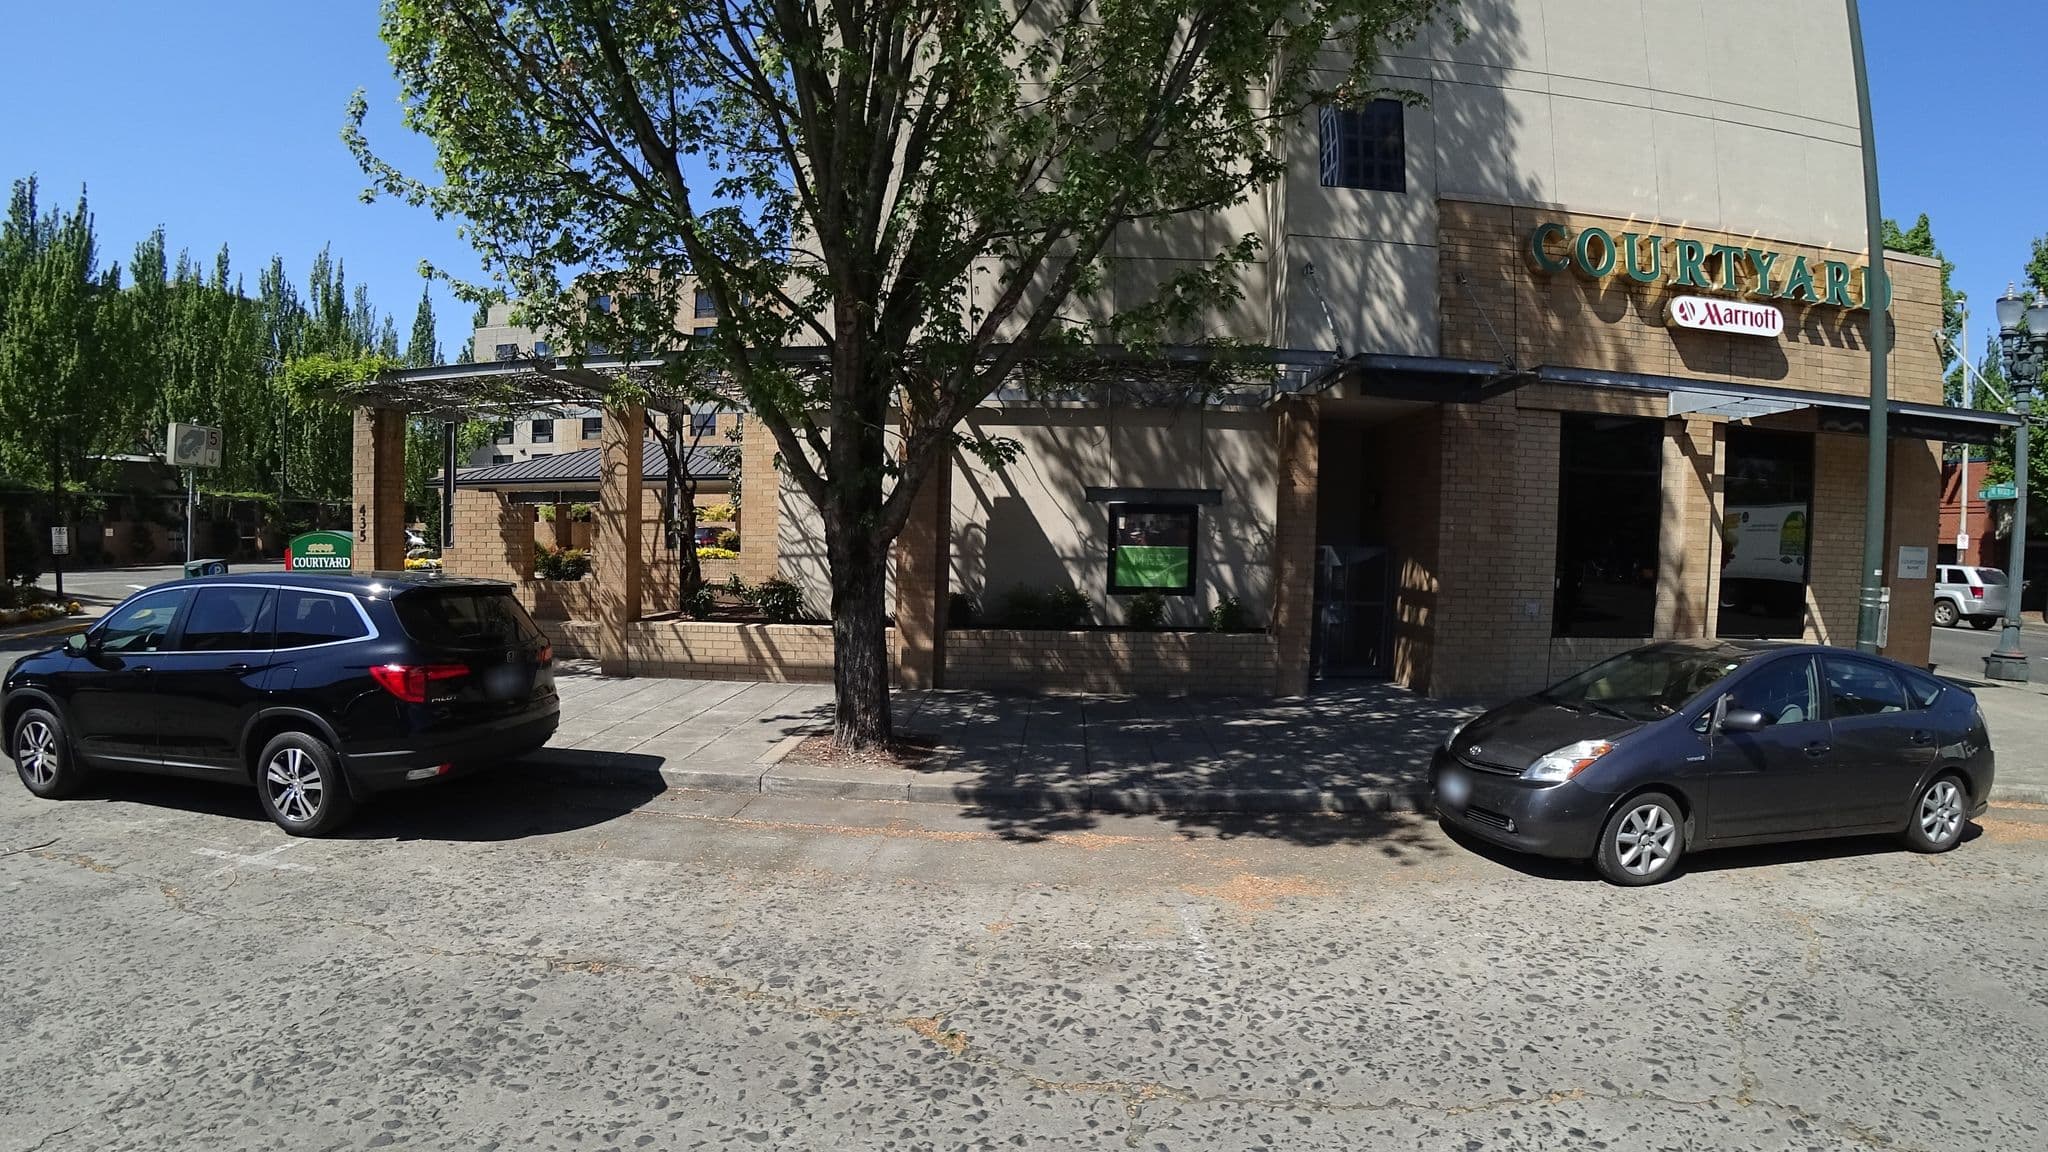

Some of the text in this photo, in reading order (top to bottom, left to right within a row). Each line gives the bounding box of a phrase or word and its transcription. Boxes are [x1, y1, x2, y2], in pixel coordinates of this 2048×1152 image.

[1532, 222, 1893, 311] COURTYARD
[1698, 302, 1776, 330] Marriott
[210, 432, 217, 445] 5
[359, 504, 367, 543] 435
[293, 557, 351, 568] COURTYARD
